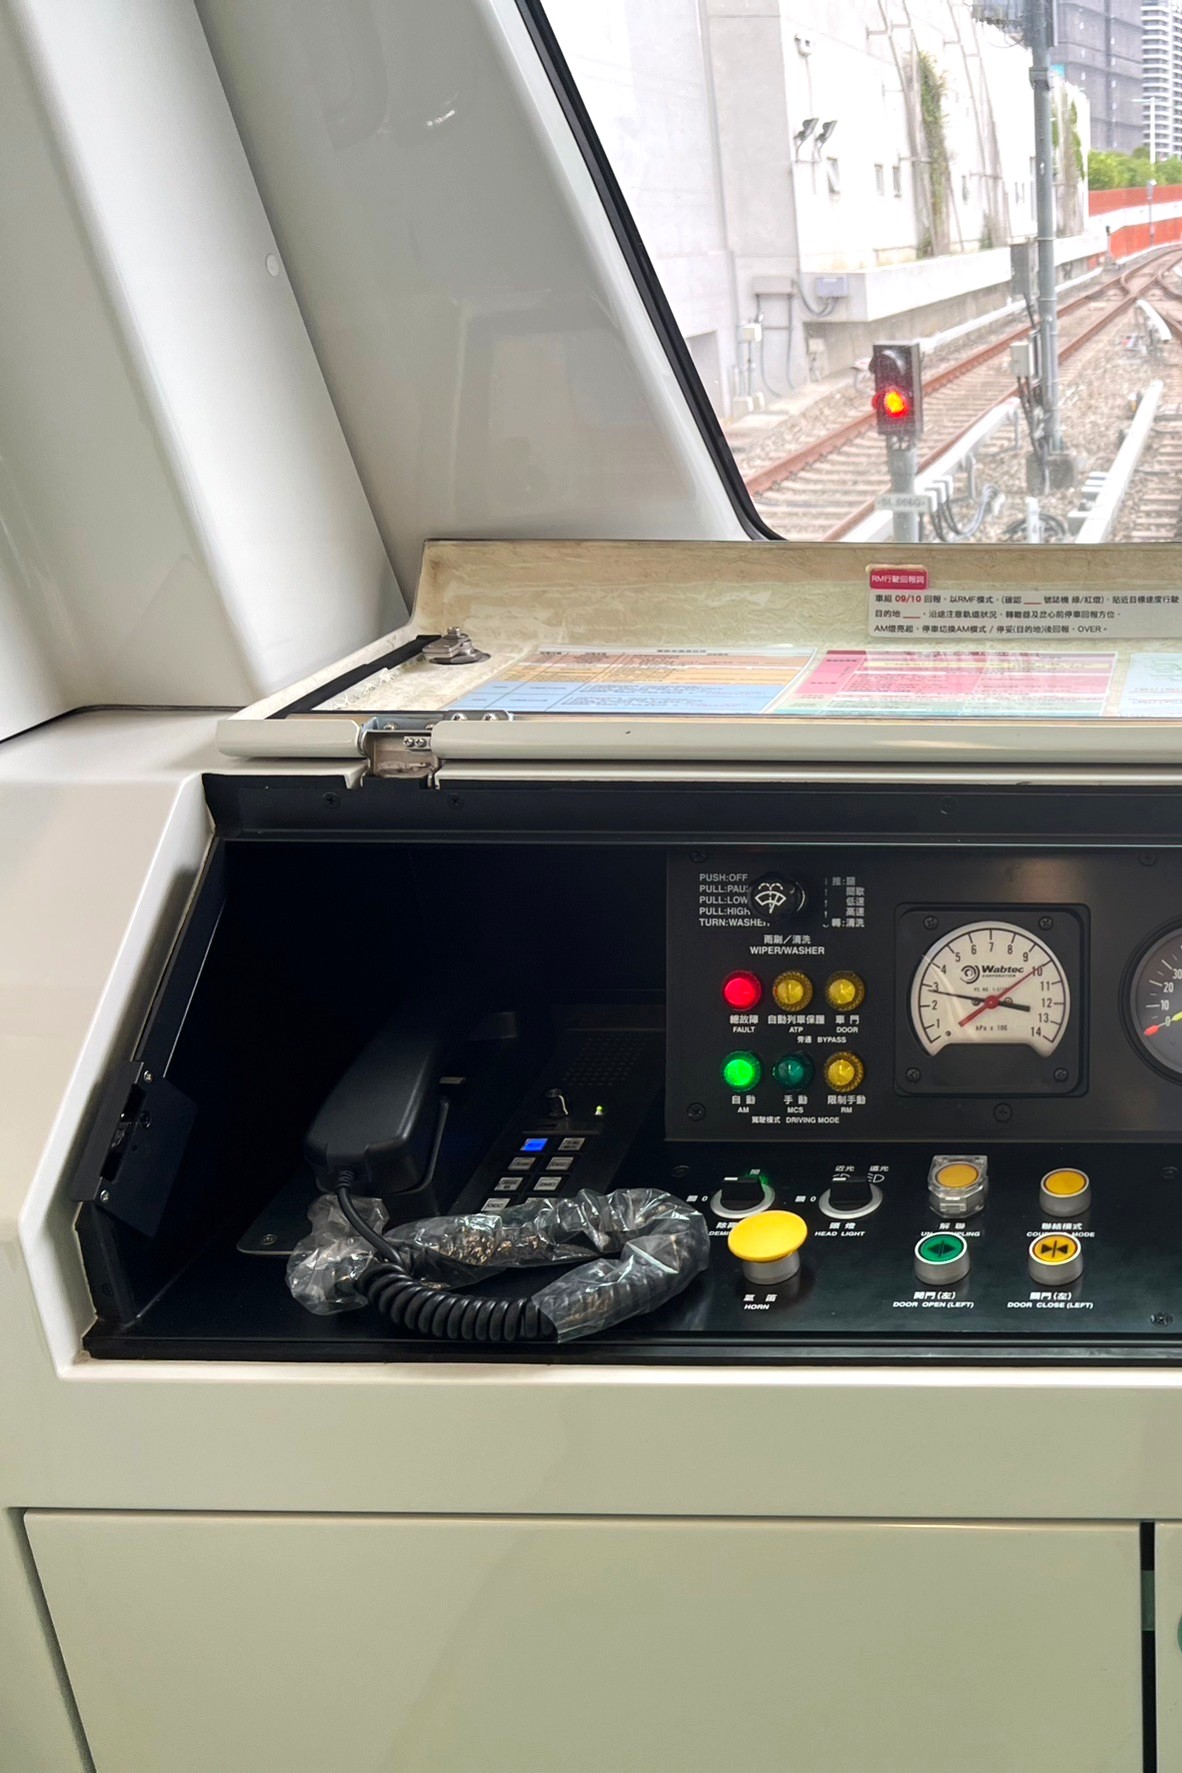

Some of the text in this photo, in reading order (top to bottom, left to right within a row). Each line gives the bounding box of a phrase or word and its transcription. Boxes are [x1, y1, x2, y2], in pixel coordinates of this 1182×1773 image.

[895, 595, 921, 603] 09/10
[875, 609, 901, 619] 目的地
[699, 873, 748, 882] PUSH:OFF
[699, 895, 748, 905] PULL:LOW
[699, 907, 750, 916] PULL:HIGH
[750, 946, 825, 955] WIPER/WASHER
[971, 944, 977, 955] 6
[989, 942, 994, 953] 7
[1007, 944, 1013, 955] 8
[955, 952, 961, 963] 5
[1023, 952, 1029, 962] 9
[940, 965, 947, 975] 4
[981, 965, 1025, 974] Wabtec
[1032, 966, 1043, 977] 10
[1172, 969, 1182, 980] 30
[933, 982, 939, 992] 3
[1040, 981, 1050, 991] 11
[1163, 982, 1174, 993] 20
[932, 1000, 938, 1010] 2
[1041, 998, 1053, 1009] 12
[1161, 1000, 1169, 1010] 10
[729, 1014, 759, 1025] 總故障
[767, 1014, 825, 1025] 自動列車保護
[835, 1014, 860, 1025] 車門
[935, 1018, 940, 1028] 1
[1038, 1013, 1049, 1023] 13
[1030, 1026, 1042, 1037] 14
[731, 1095, 756, 1105] 自動
[783, 1095, 808, 1105] 手動
[827, 1095, 866, 1105] 限制手動
[787, 1106, 804, 1114] MCS
[751, 1115, 781, 1124] 駕駛模式
[913, 1291, 956, 1300] 開門(左)
[1029, 1291, 1072, 1300] 關門(左)
